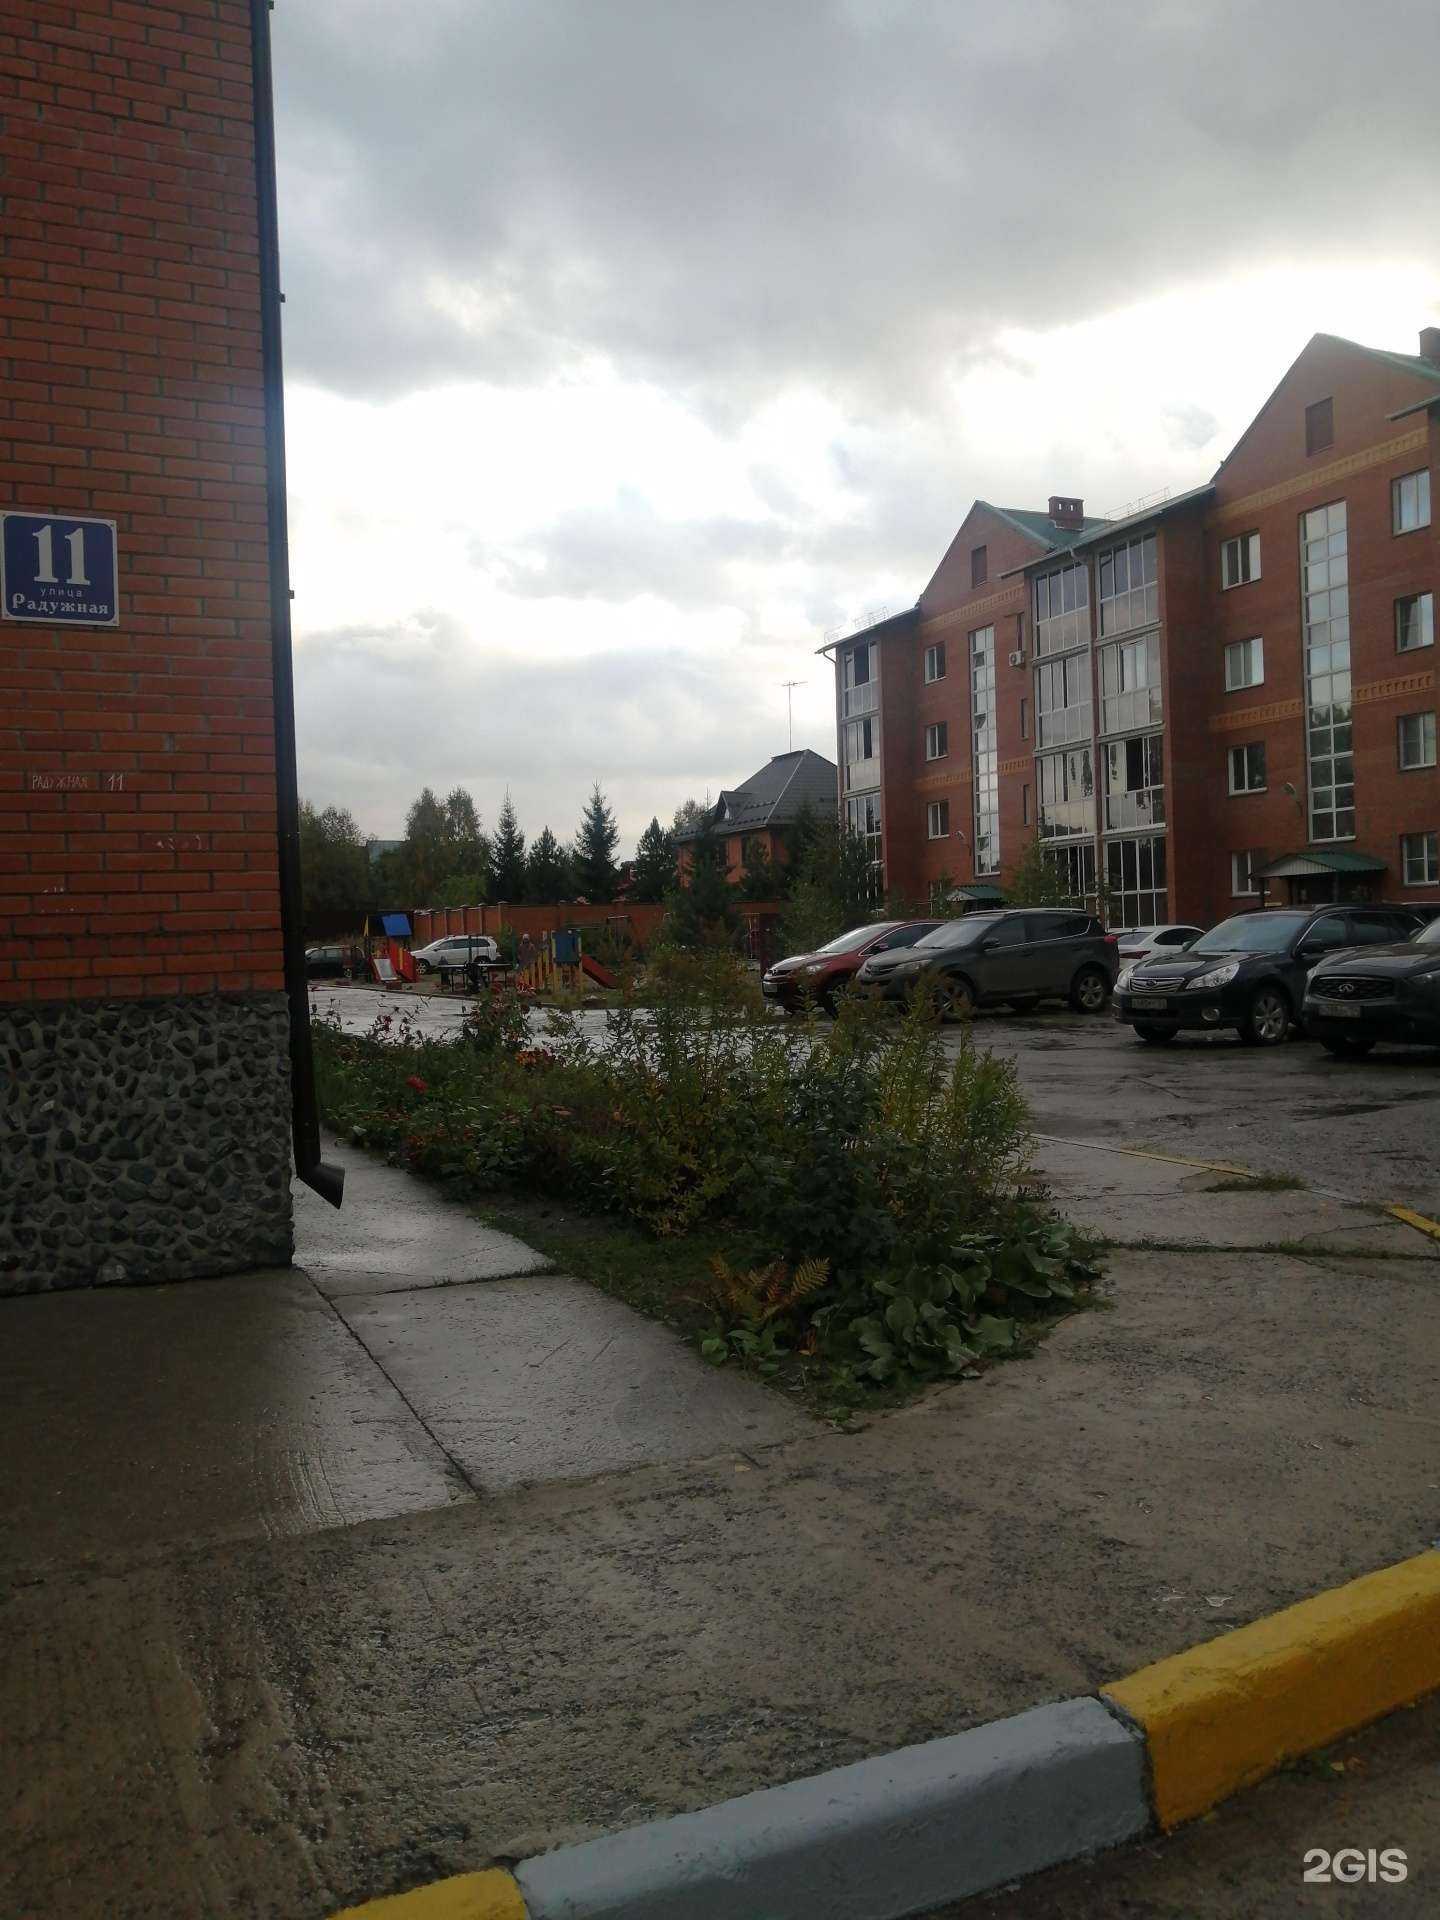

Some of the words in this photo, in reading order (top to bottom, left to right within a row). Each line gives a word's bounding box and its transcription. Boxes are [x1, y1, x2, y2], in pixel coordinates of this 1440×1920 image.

[32, 524, 91, 585] 11
[12, 592, 108, 614] Радужная
[40, 587, 83, 599] улица
[107, 773, 124, 791] 11
